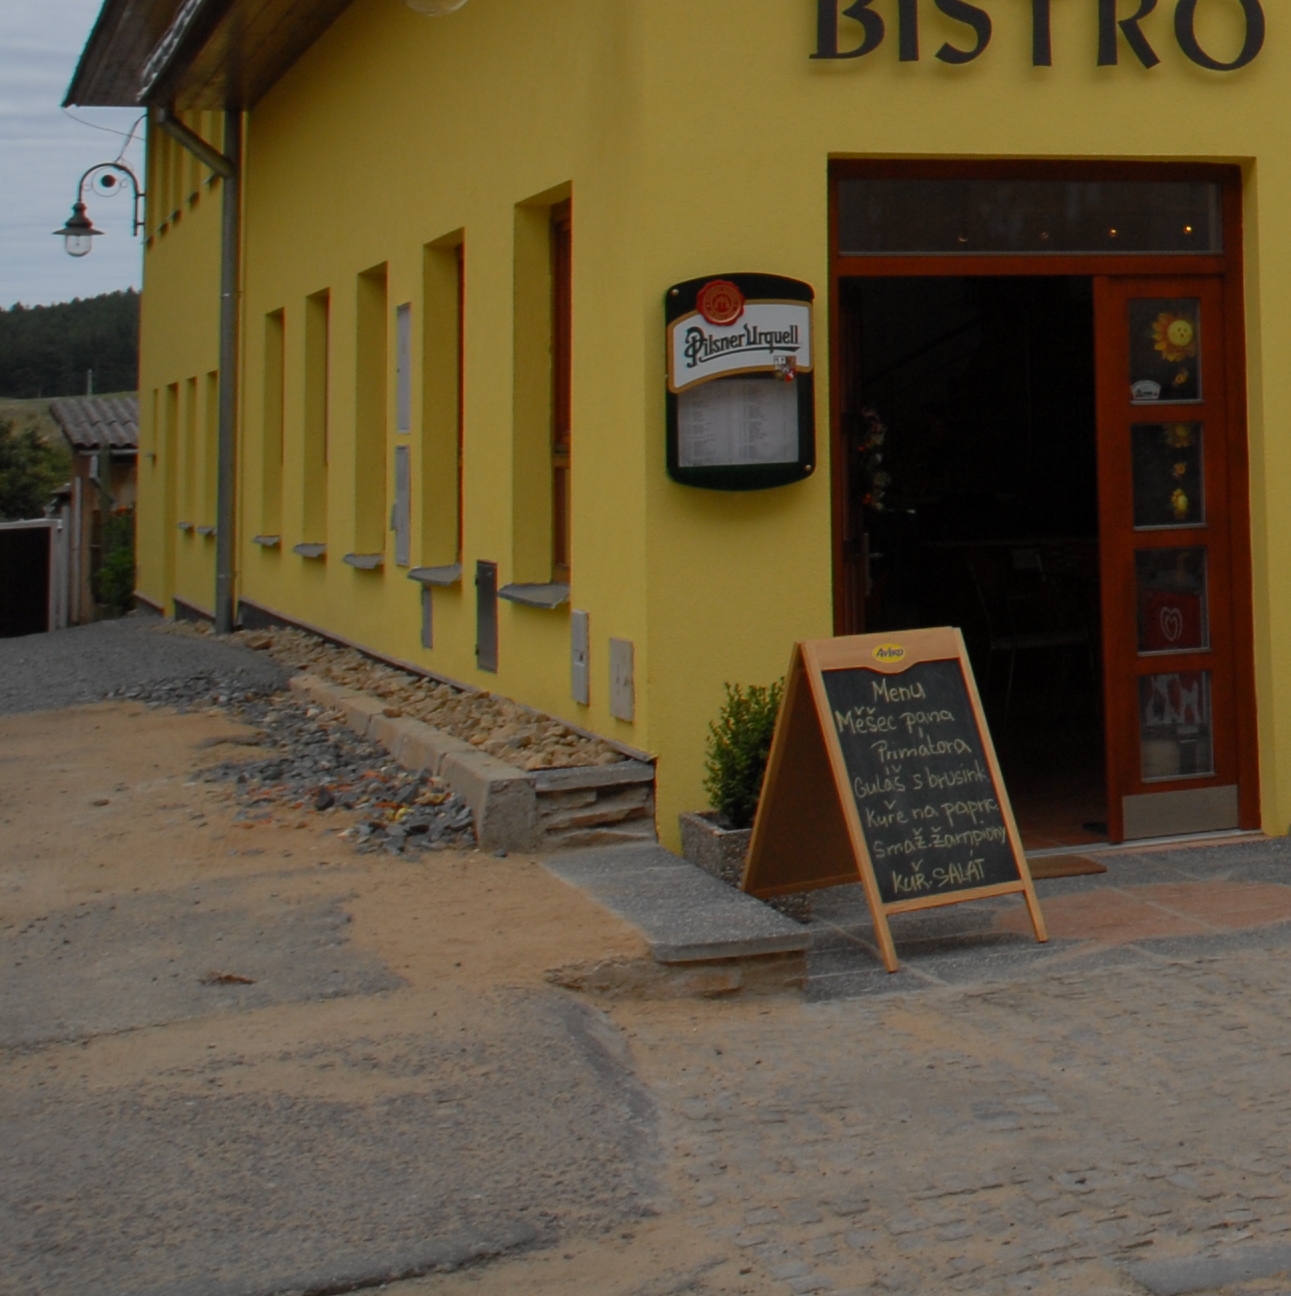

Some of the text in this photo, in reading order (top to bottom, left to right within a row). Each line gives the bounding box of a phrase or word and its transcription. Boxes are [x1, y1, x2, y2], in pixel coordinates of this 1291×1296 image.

[684, 323, 799, 368] Pilsner Urquell
[872, 678, 926, 702] Menu
[834, 706, 897, 734] Měšec
[912, 805, 939, 819] na
